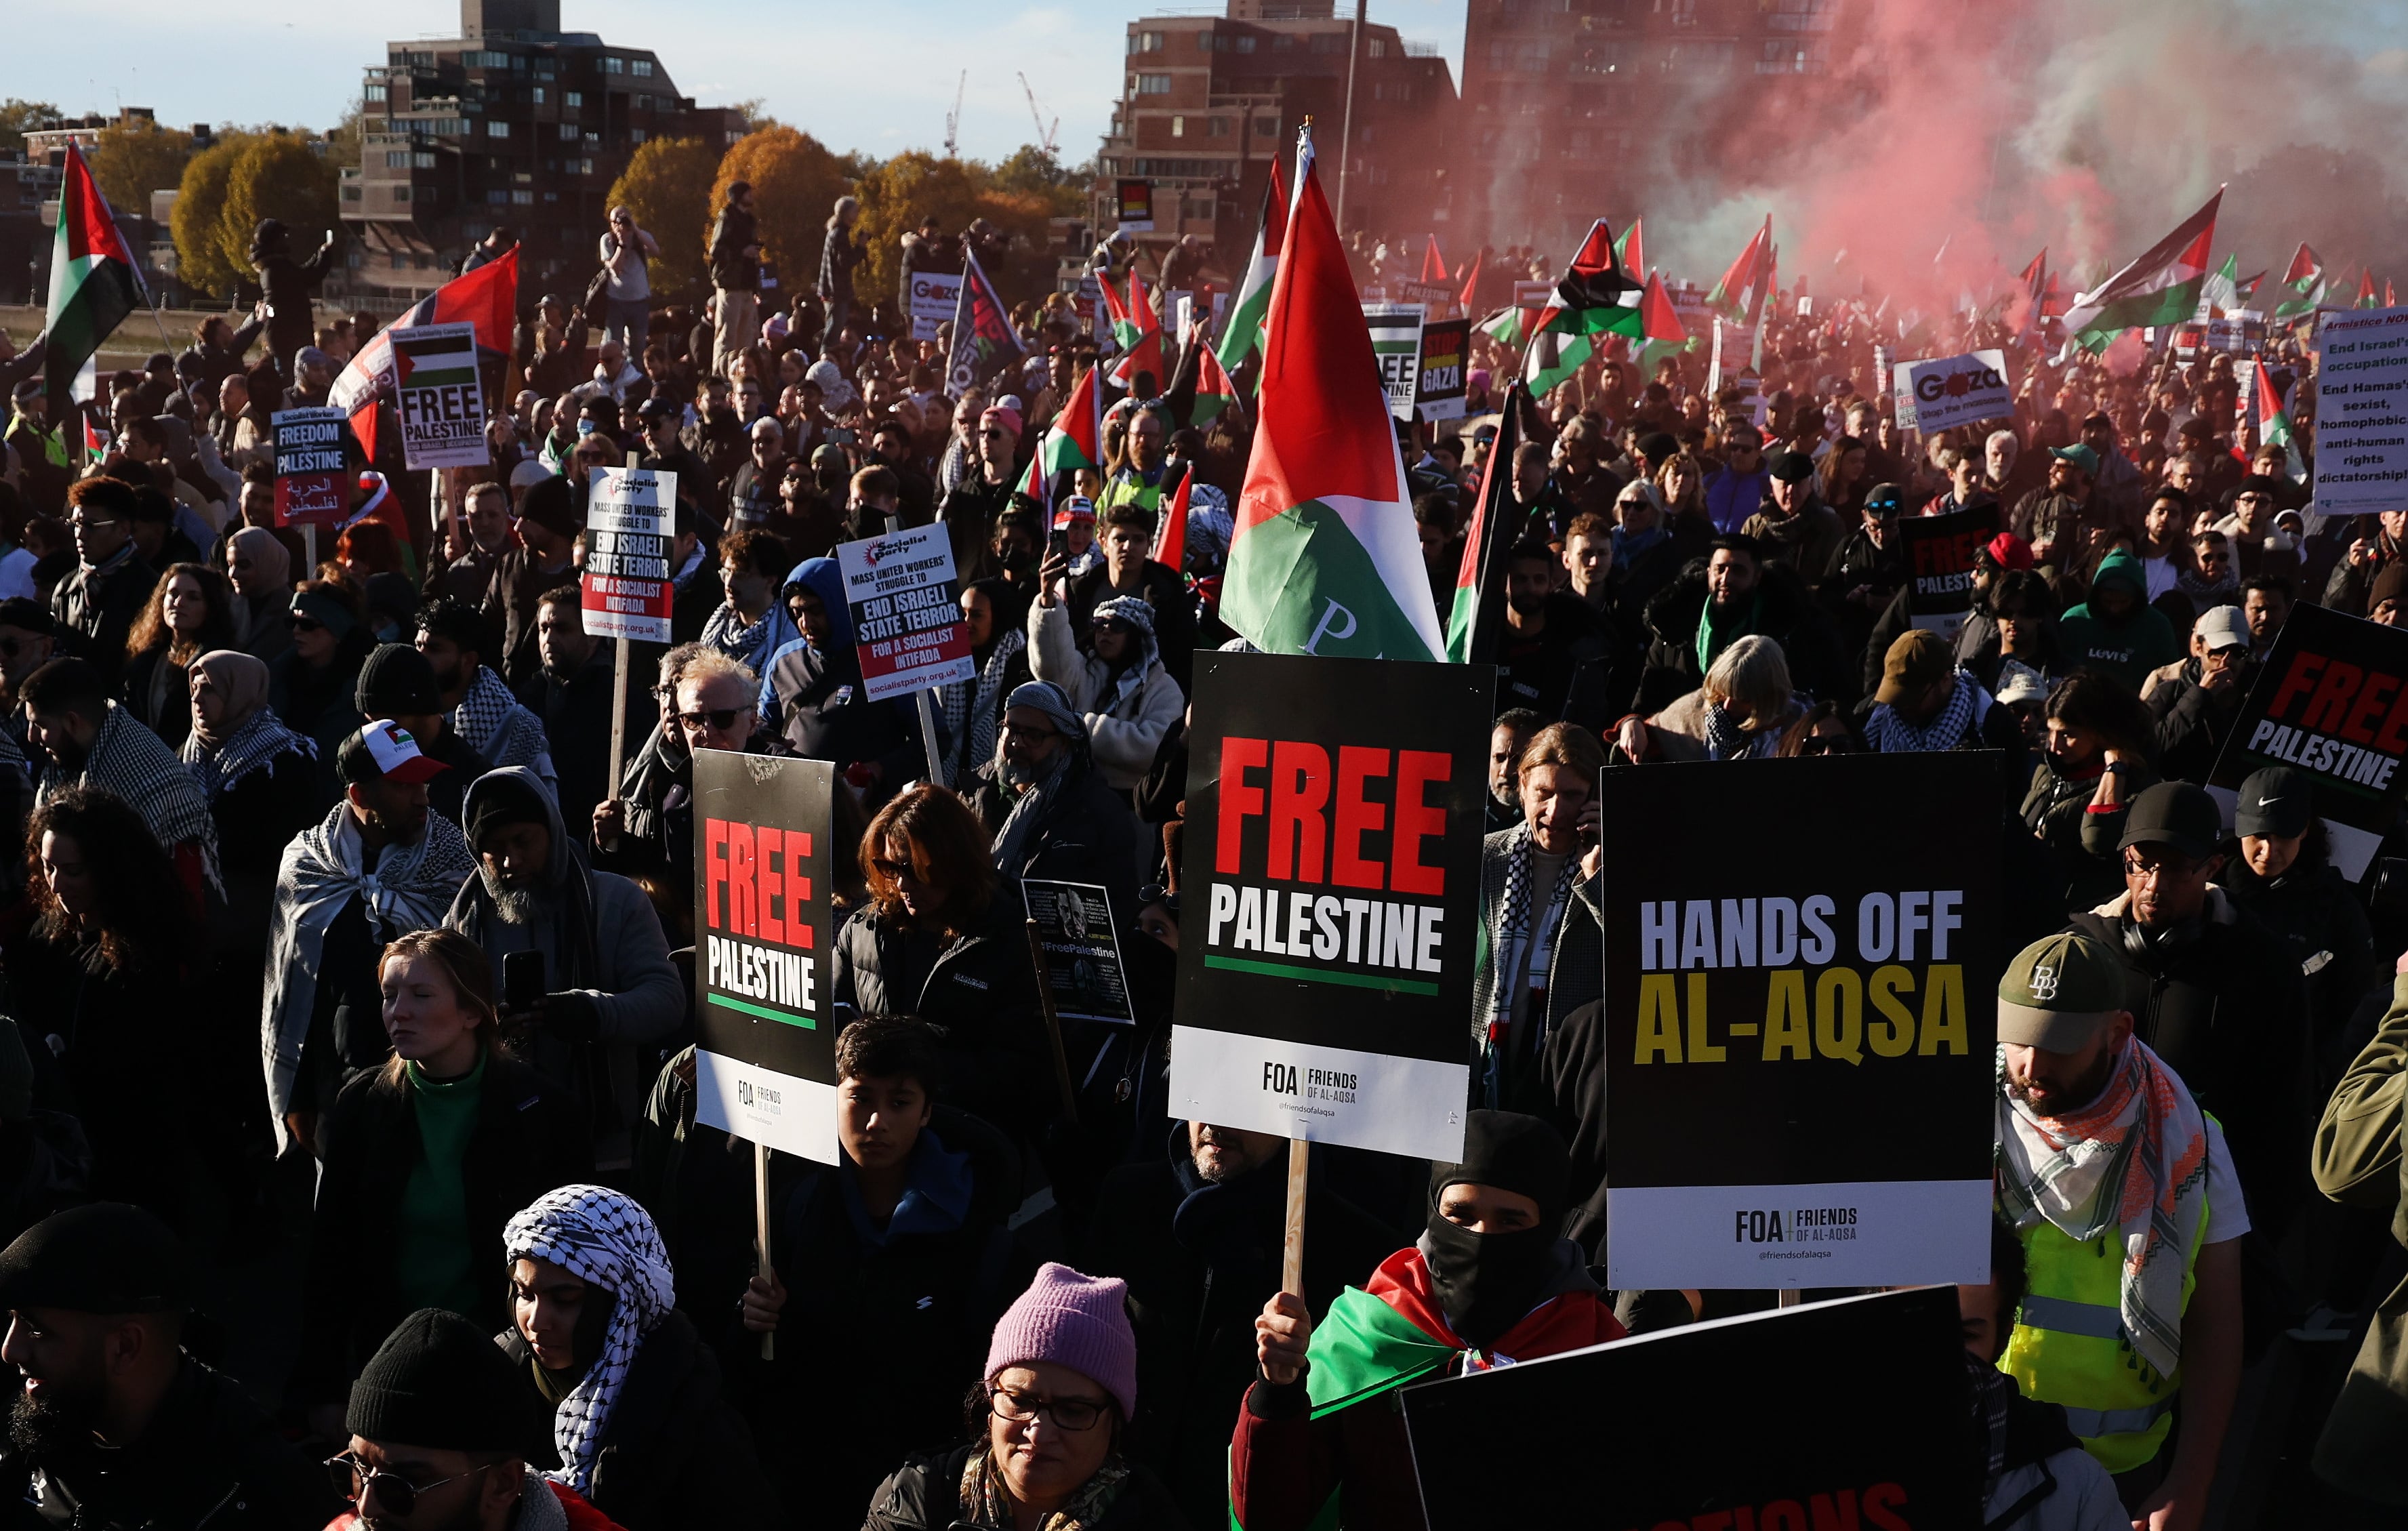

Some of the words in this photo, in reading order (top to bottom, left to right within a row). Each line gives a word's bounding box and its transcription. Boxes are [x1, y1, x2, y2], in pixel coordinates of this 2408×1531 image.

[2325, 319, 2382, 331] Armistice
[1425, 331, 1462, 356] STOP
[2329, 342, 2355, 354] End
[1381, 354, 1415, 383] EE
[2327, 356, 2407, 373] occupation
[1423, 365, 1460, 393] GAZA
[1917, 368, 2003, 402] Gza
[2322, 383, 2348, 396] End
[401, 384, 481, 424] FREE
[1921, 408, 1944, 420] Stop
[1944, 403, 1961, 413] the
[2342, 399, 2390, 412] sexist,
[282, 411, 308, 422] Socialist
[310, 410, 335, 419] Worker
[279, 423, 339, 446] FREEDOM
[405, 420, 482, 441] PALESTINE
[302, 443, 314, 452] for
[2325, 436, 2405, 449] anti-human
[277, 451, 344, 474] PALESTINE
[2343, 454, 2385, 468] rights
[287, 477, 331, 498] الحرية
[618, 476, 659, 488] Socialist
[283, 495, 338, 518] لفلسطين
[594, 502, 611, 513] MASS
[611, 504, 632, 515] UNITED
[634, 505, 669, 518] WORKERS'
[609, 516, 640, 529] STRUGGLE
[642, 518, 651, 529] TO
[596, 531, 615, 554] END
[617, 533, 664, 557] ISRAELI
[876, 534, 927, 552] Socialist
[588, 552, 619, 575] STATE
[623, 555, 670, 579] TERROR
[851, 571, 875, 586] MASS
[876, 565, 903, 579] UNITED
[906, 554, 945, 572] WORKERS'
[592, 577, 607, 592] FOR
[608, 578, 615, 593] A
[615, 579, 661, 598] SOCIALIST
[876, 577, 915, 593] STRUGGLE
[917, 572, 927, 583] TO
[1916, 571, 1971, 596] PALEST
[606, 595, 645, 613] INTIFADA
[863, 597, 891, 621] END
[894, 584, 947, 614] ISRAELI
[584, 618, 655, 635] socialistparty.org.uk
[859, 613, 903, 641] STATE
[904, 603, 960, 632] TERROR
[872, 641, 892, 659] FOR
[894, 639, 902, 653] A
[903, 627, 954, 649] SOCIALIST
[894, 648, 941, 670] INTIFADA
[870, 669, 958, 695] socialistparty.org.uk
[2267, 651, 2408, 755] FREE
[2247, 719, 2401, 791] PALESTINE
[1215, 736, 1452, 896] FREE
[705, 817, 813, 950] FREE
[1207, 883, 1444, 974] PALESTINE
[1639, 894, 1836, 970] HANDS
[1858, 890, 1964, 963] OFF
[708, 934, 816, 1012] PALESTINE
[1633, 963, 1969, 1067] AL-AQSA
[1263, 1061, 1297, 1096] FOA
[1309, 1068, 1357, 1090] FRIENDS
[739, 1080, 754, 1107] FOA
[758, 1086, 781, 1105] FRIENDS
[1307, 1086, 1318, 1099] OF
[1320, 1088, 1356, 1104] AL-AQSA
[1279, 1102, 1335, 1117] @friendsofalaqsa
[1736, 1210, 1784, 1243] FOA
[1797, 1208, 1857, 1227] FRIENDS
[1797, 1229, 1809, 1242] OF
[1812, 1227, 1857, 1242] AL-AQSA
[1759, 1250, 1832, 1260] @friendsofalaqsa
